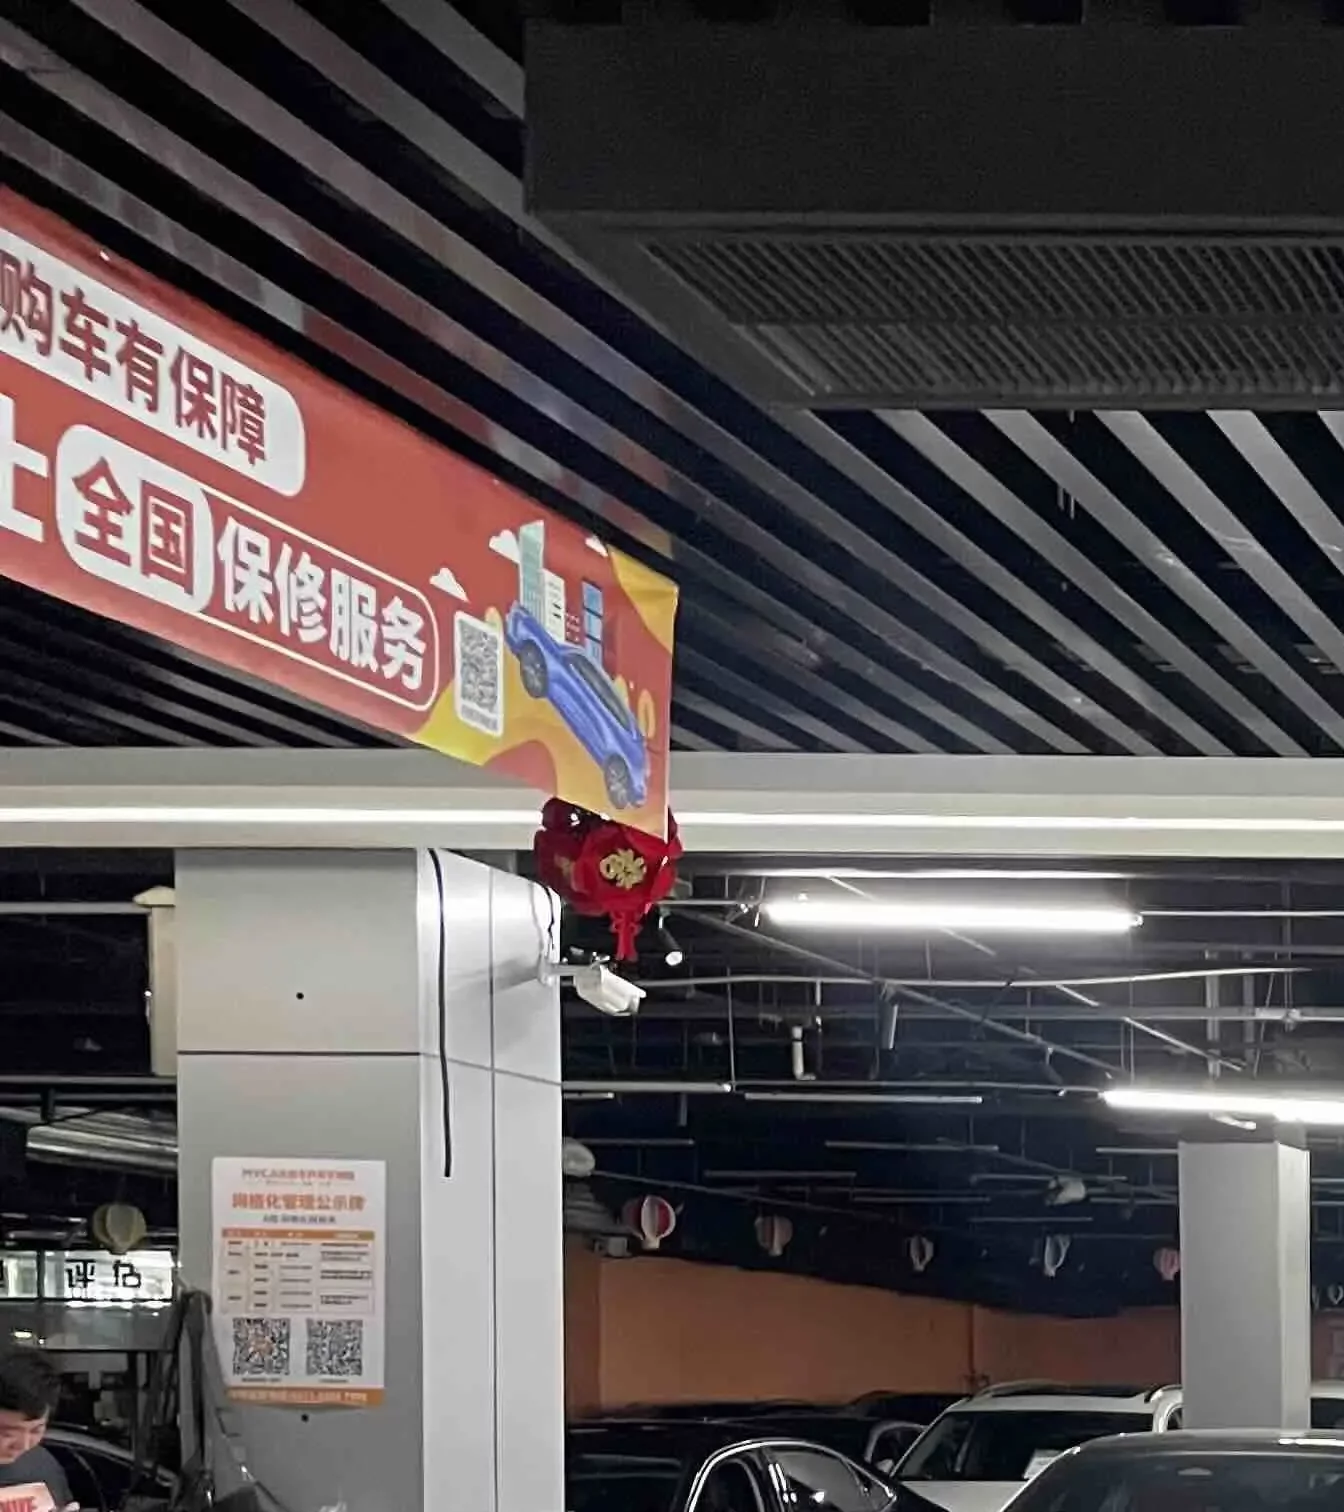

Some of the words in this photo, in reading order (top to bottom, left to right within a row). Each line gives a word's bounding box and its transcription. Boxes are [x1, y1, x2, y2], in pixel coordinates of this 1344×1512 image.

[0, 253, 267, 466] 购车有保障
